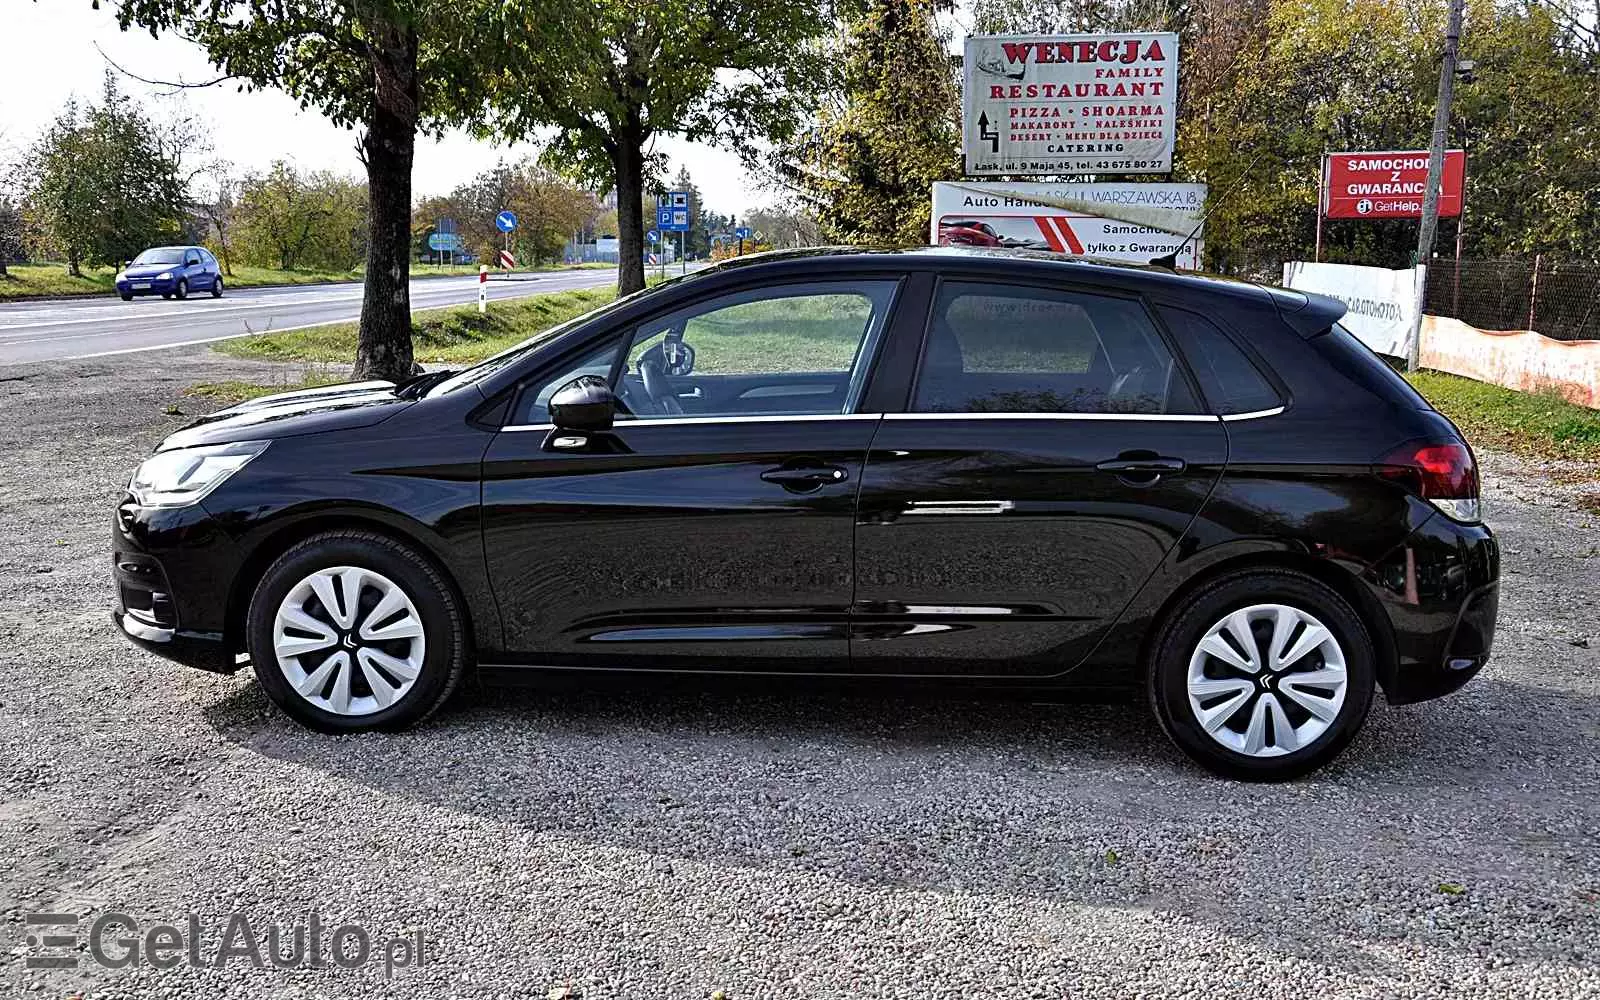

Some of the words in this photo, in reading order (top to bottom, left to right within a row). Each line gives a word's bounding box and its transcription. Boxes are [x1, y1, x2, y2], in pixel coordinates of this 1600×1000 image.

[1001, 39, 1165, 64] WENECJA
[1095, 67, 1164, 78] FAMILY
[990, 82, 1164, 99] RESTAURANT
[1010, 107, 1060, 118] PIZZA
[1081, 105, 1164, 117] SHOARMA
[1010, 121, 1075, 130] MAKARONY
[1096, 118, 1162, 128] NALEŚNIKI
[1065, 132, 1096, 140] MENU
[1099, 132, 1120, 140] DLA
[1124, 131, 1163, 139] DZIECI
[1047, 144, 1124, 153] CATERING
[1005, 162, 1018, 170] ul.
[1020, 162, 1027, 170] 9
[1030, 162, 1054, 171] Maja
[1057, 161, 1073, 170] 45,
[1076, 161, 1094, 169] tel.
[1096, 161, 1109, 169] 43
[1112, 161, 1131, 169] 675
[1134, 161, 1147, 169] 80
[1347, 158, 1445, 171] SAMOCHOD
[1390, 171, 1401, 182] Z
[1347, 183, 1443, 196] GWARANC
[964, 196, 999, 207] Auto
[1004, 196, 1050, 207] Han
[1091, 190, 1183, 204] WARSZAWSKA
[662, 213, 669, 223] P
[1103, 224, 1176, 236] Samoch
[1088, 242, 1117, 254] tylko
